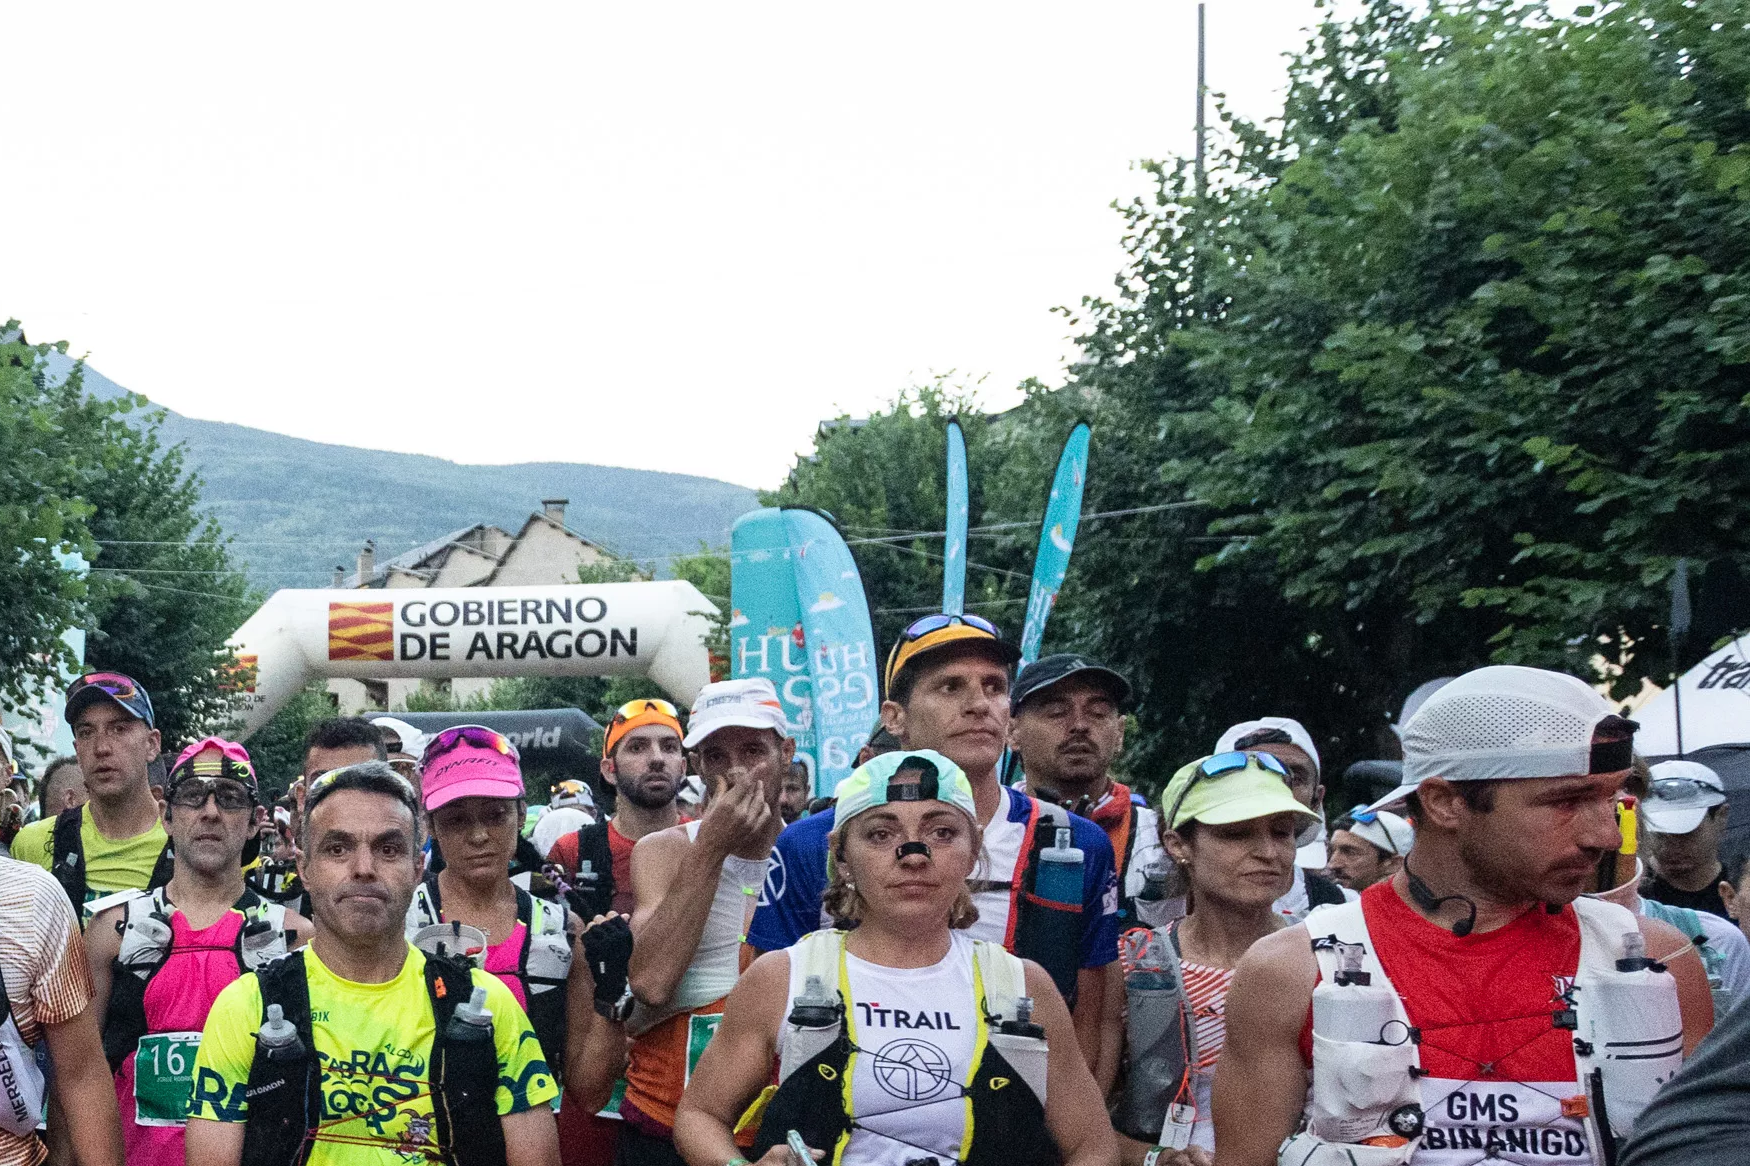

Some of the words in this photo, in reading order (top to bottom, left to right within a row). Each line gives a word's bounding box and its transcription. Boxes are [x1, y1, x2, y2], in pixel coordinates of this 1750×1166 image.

[400, 597, 608, 628] GOBIERNO
[399, 632, 451, 661] DE
[434, 757, 498, 780] DYNAFIT
[150, 1042, 186, 1077] 16
[1446, 1091, 1519, 1124] GMS
[1418, 1123, 1585, 1157] BIÑÁNIGO
